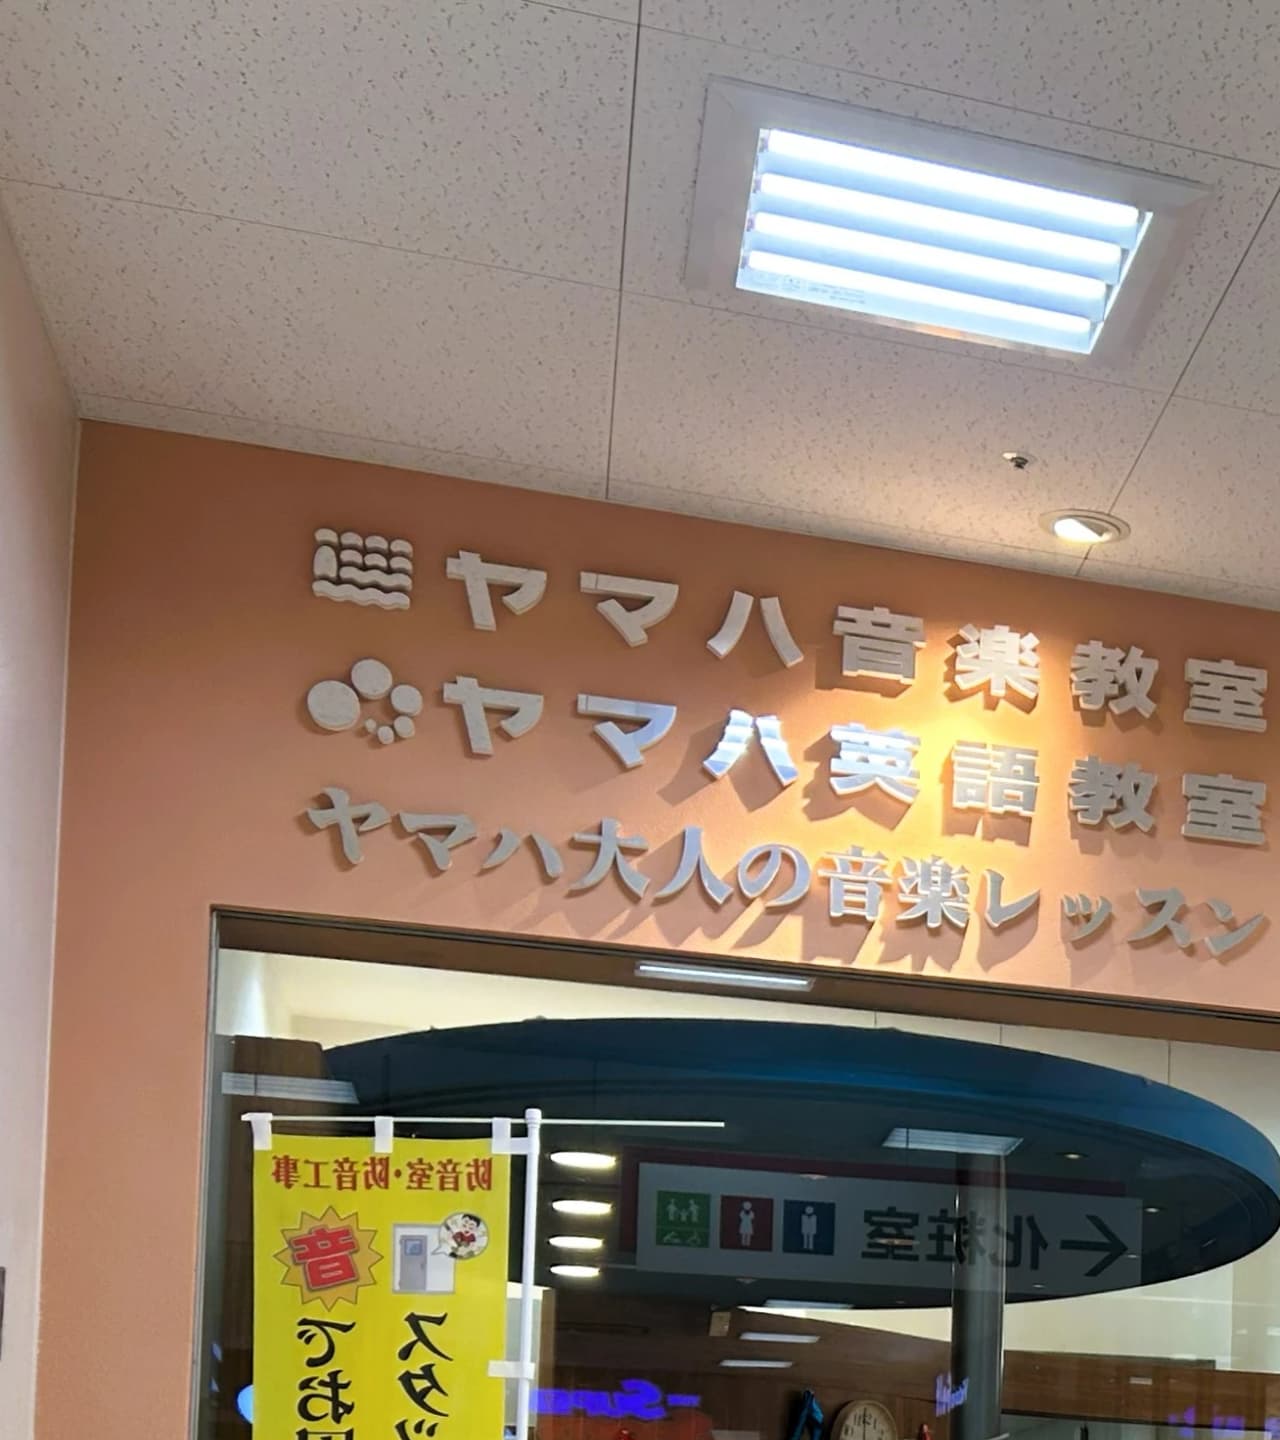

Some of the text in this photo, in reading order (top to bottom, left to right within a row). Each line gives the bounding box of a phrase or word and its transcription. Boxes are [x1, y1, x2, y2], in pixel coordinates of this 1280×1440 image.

[446, 550, 1268, 733] ヤマハ音楽教室
[443, 675, 1267, 846] ヤマハ英語教室
[307, 787, 1266, 957] ヤマハ大人の音楽レッスン
